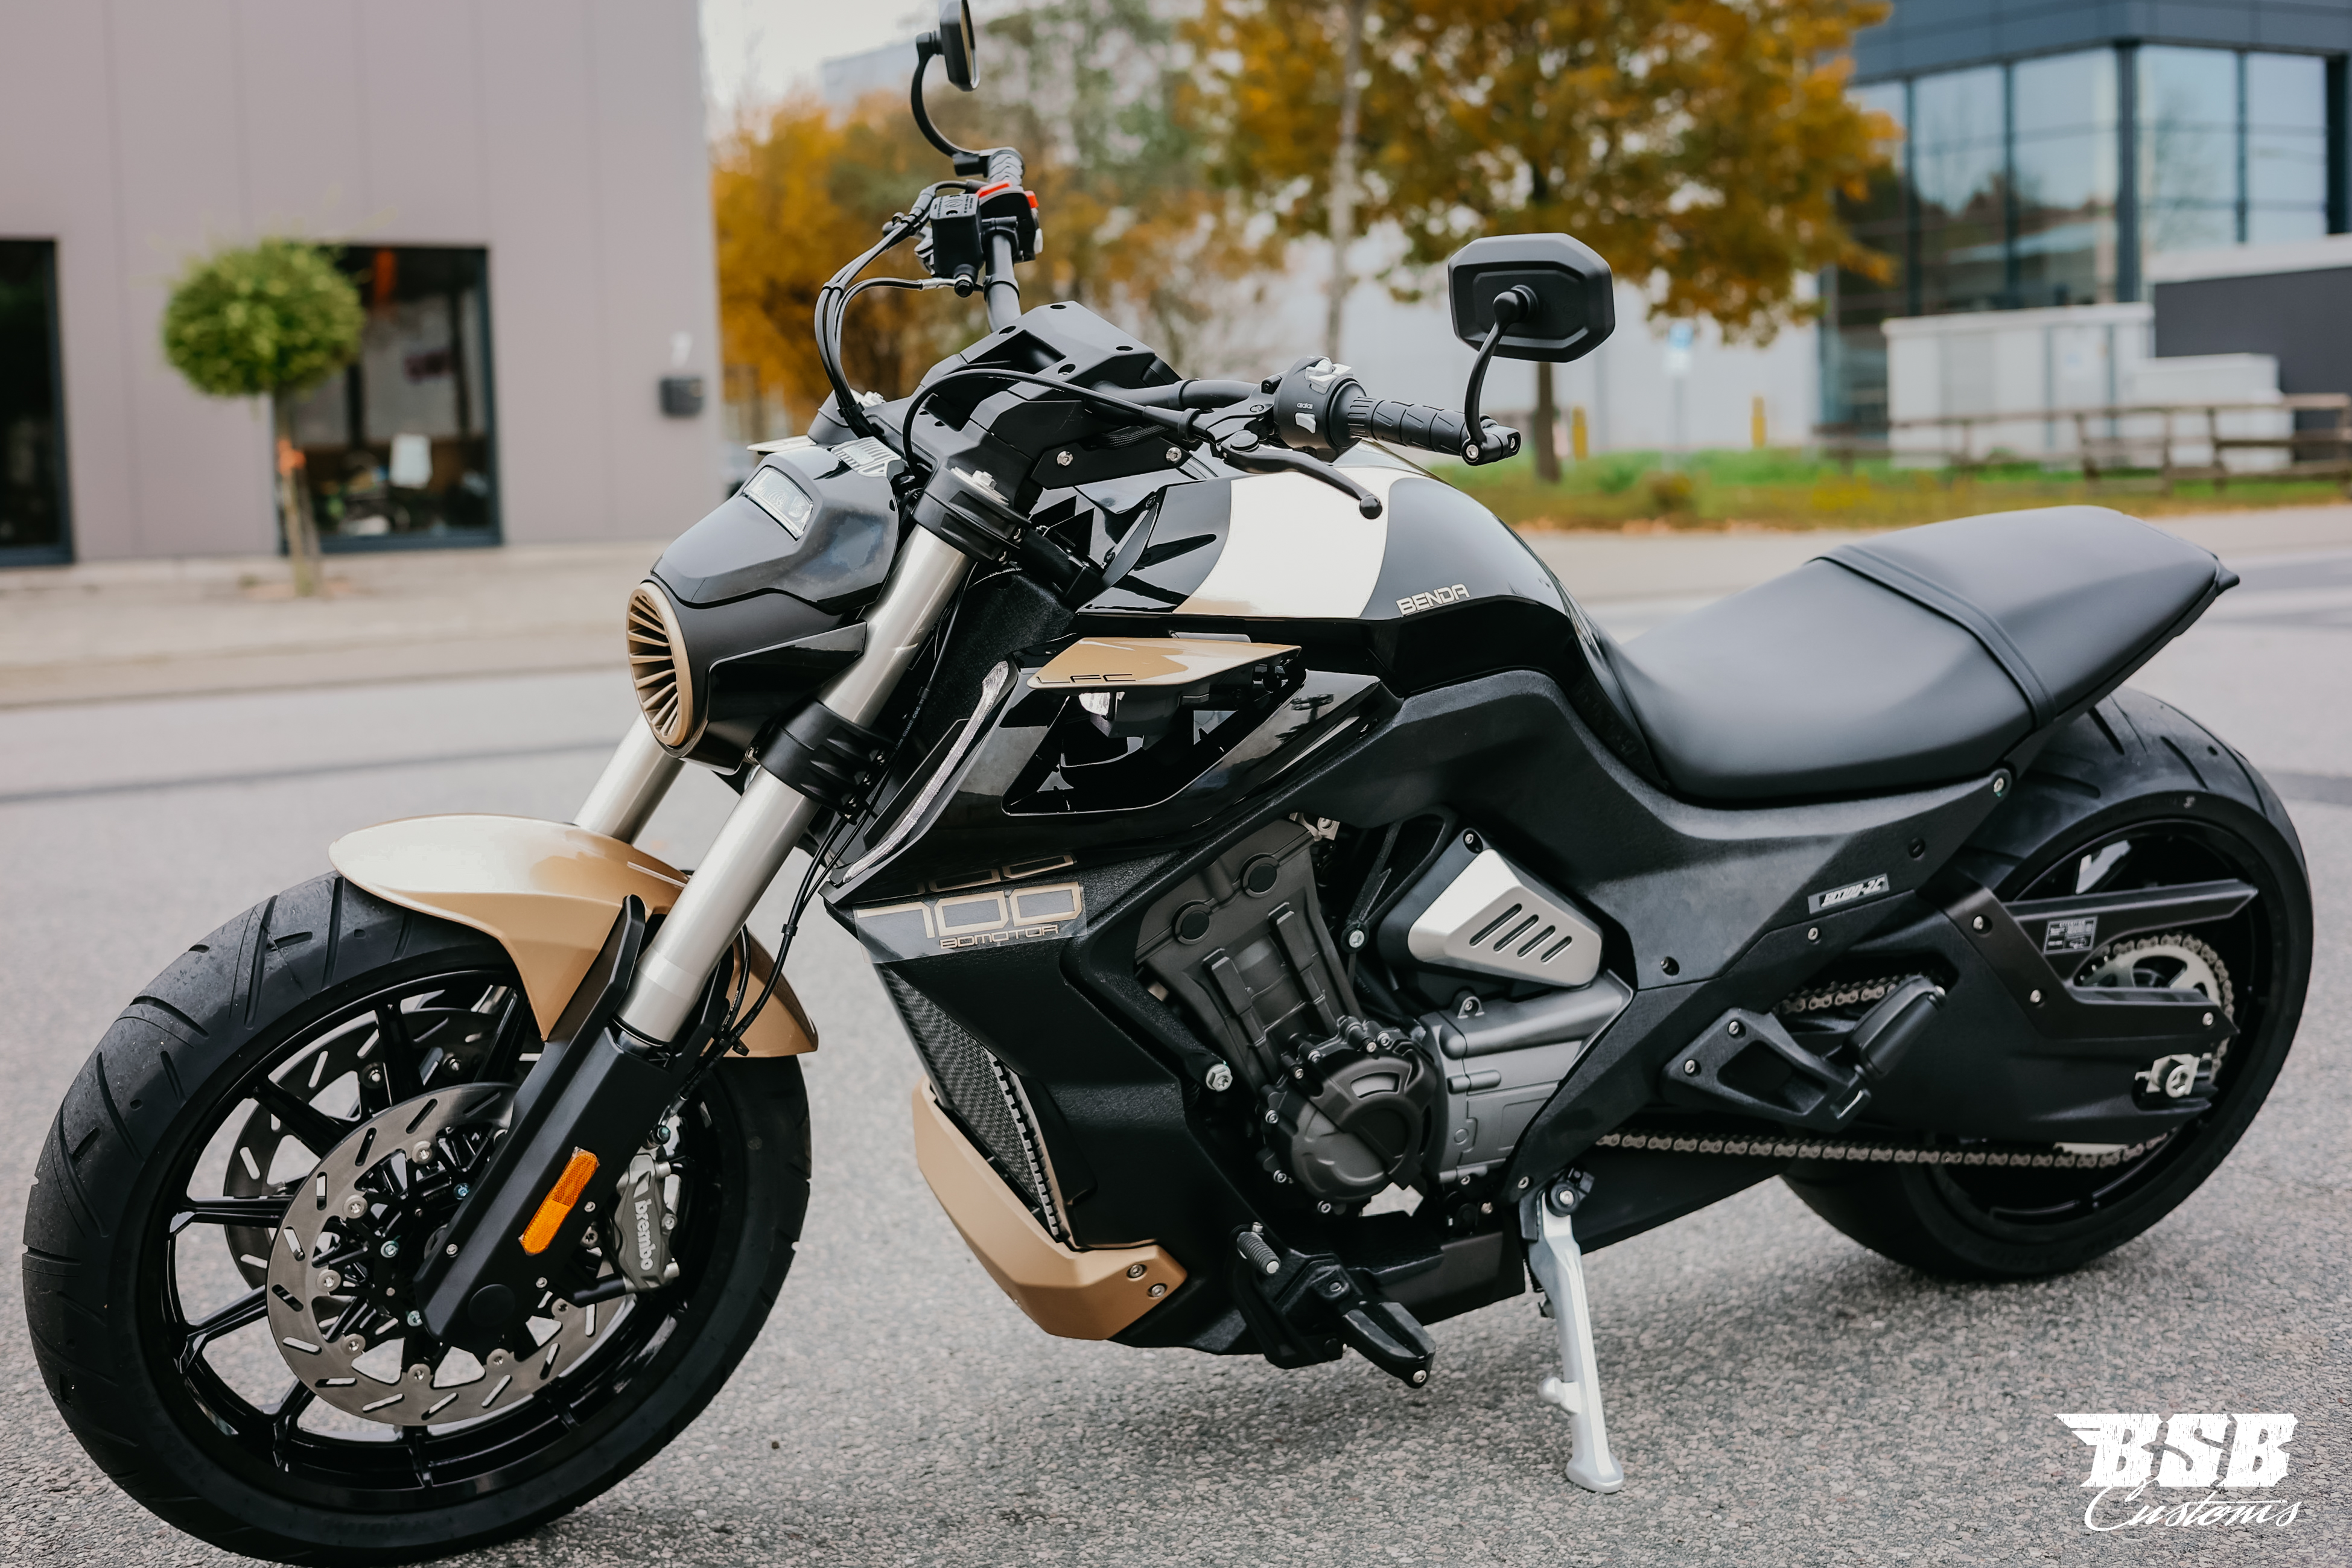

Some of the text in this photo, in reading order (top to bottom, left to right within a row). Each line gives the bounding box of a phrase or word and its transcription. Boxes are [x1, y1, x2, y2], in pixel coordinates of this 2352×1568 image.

[1396, 583, 1470, 616] BENDA
[1036, 674, 1136, 684] LFC
[857, 881, 1082, 938] 700
[939, 924, 1059, 949] BDMOTOR
[635, 1198, 656, 1271] brembo
